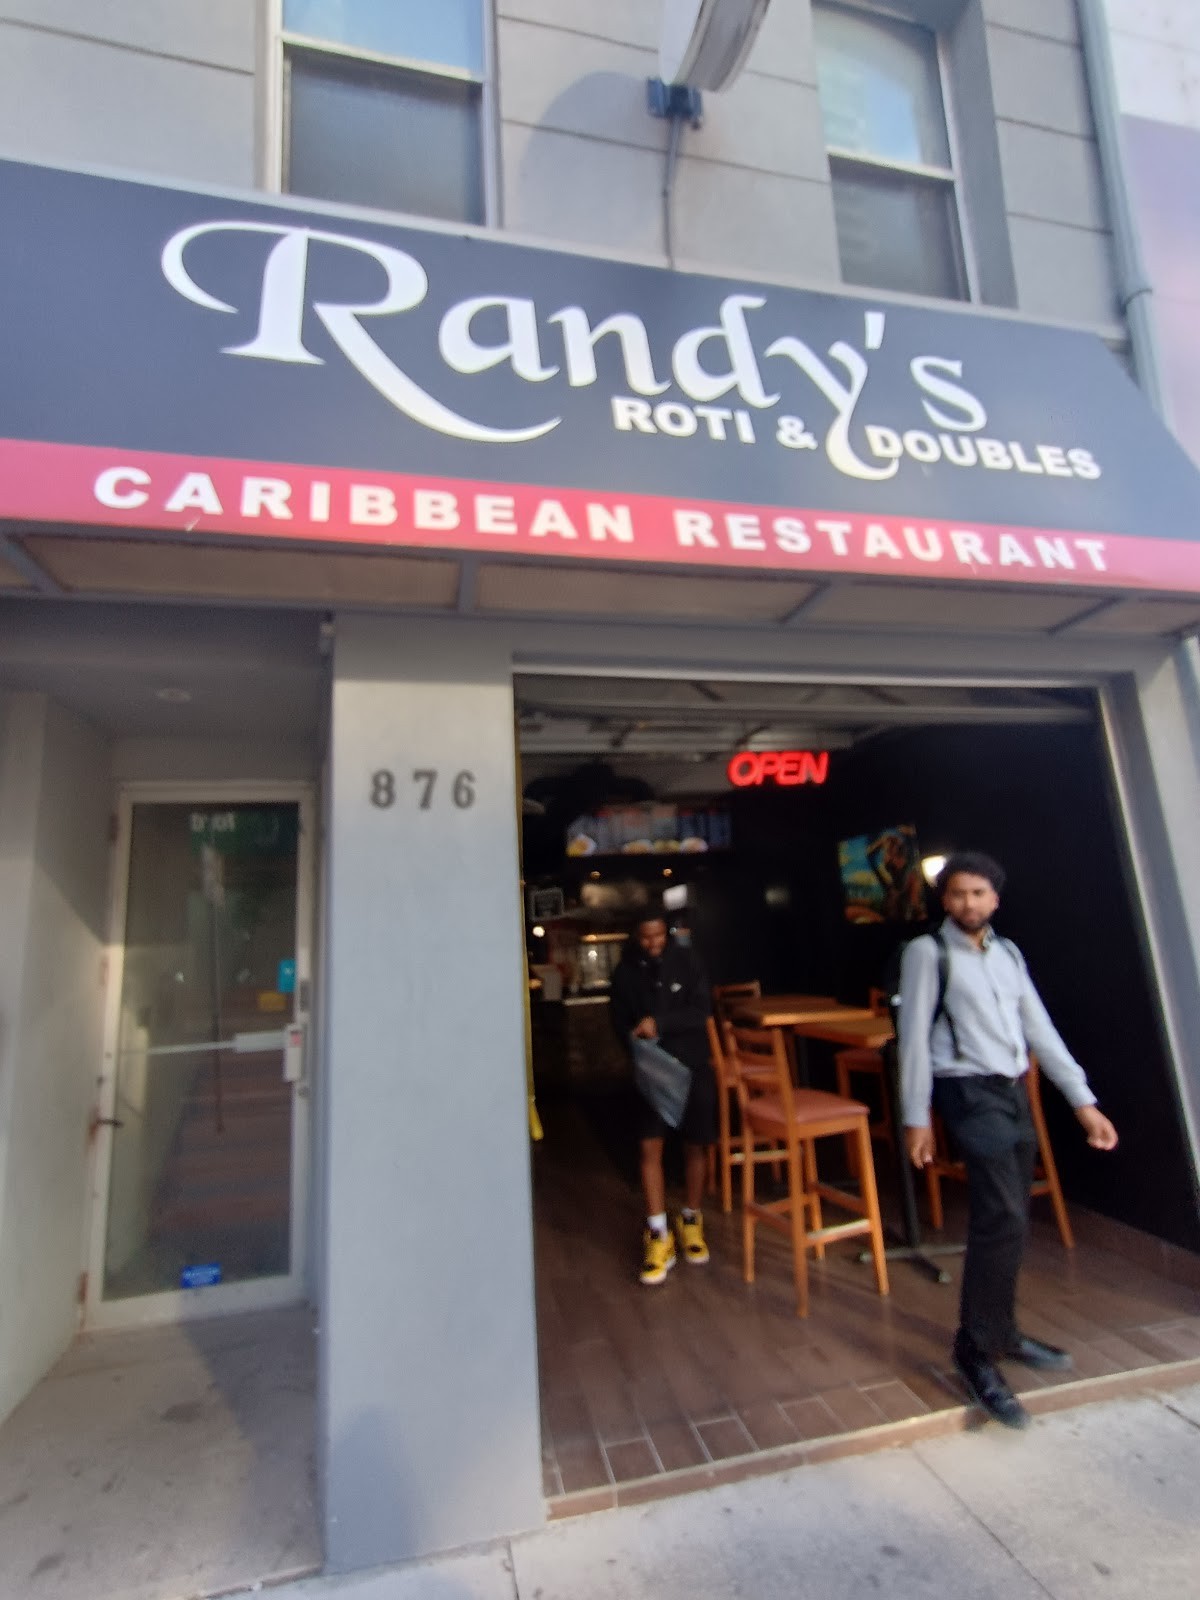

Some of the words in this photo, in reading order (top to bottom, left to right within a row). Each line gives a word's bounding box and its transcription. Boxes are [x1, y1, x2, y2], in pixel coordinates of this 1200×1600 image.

[161, 220, 987, 480] Randy's
[611, 396, 756, 443] ROTI
[776, 416, 818, 450] &
[865, 425, 1101, 480] DOUBLES
[93, 466, 634, 542] CARIBBEAN
[673, 509, 1109, 572] RESTAURANT
[369, 768, 477, 811] 876
[728, 751, 830, 787] OPEN
